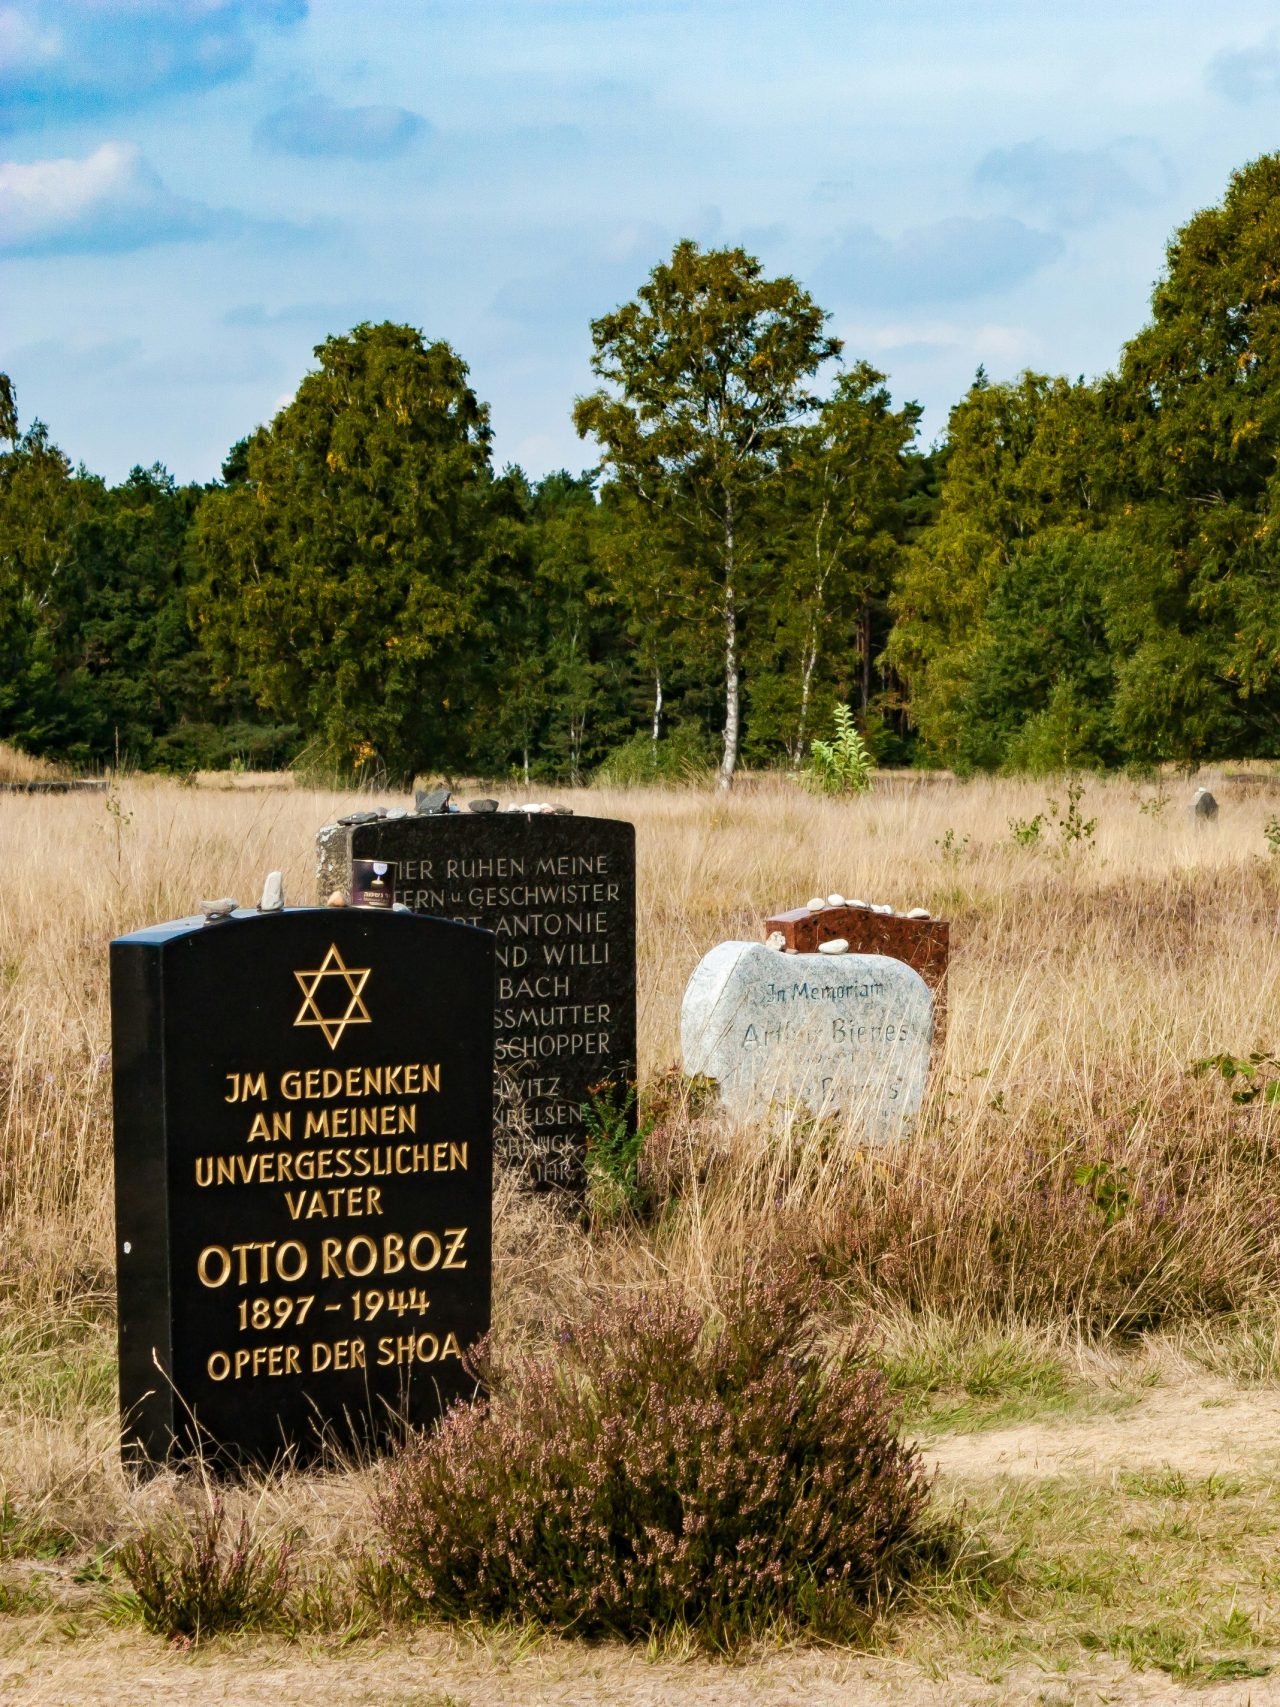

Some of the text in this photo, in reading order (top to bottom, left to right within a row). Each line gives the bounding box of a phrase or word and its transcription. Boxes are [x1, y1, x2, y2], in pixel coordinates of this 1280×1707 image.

[399, 855, 610, 881] IER RUHEN MEINE
[393, 889, 446, 909] TERN
[468, 883, 621, 907] GESCHWISTER
[496, 911, 609, 937] ANTONIE
[495, 943, 610, 968] ND WILLI
[494, 1004, 611, 1028] SSMUTTER
[741, 1021, 825, 1050] Arth
[281, 1064, 440, 1100] GEDENKEN
[500, 1077, 561, 1098] WITZ
[248, 1104, 415, 1142] AN MEINEN
[196, 1142, 467, 1187] UNVERGESSLICHEN
[285, 1187, 383, 1220] VATER
[198, 1228, 467, 1288] OTTO ROBOZ
[239, 1296, 314, 1330] 1897
[352, 1288, 430, 1321] 1944
[208, 1333, 462, 1380] OPFER DER SHOA
